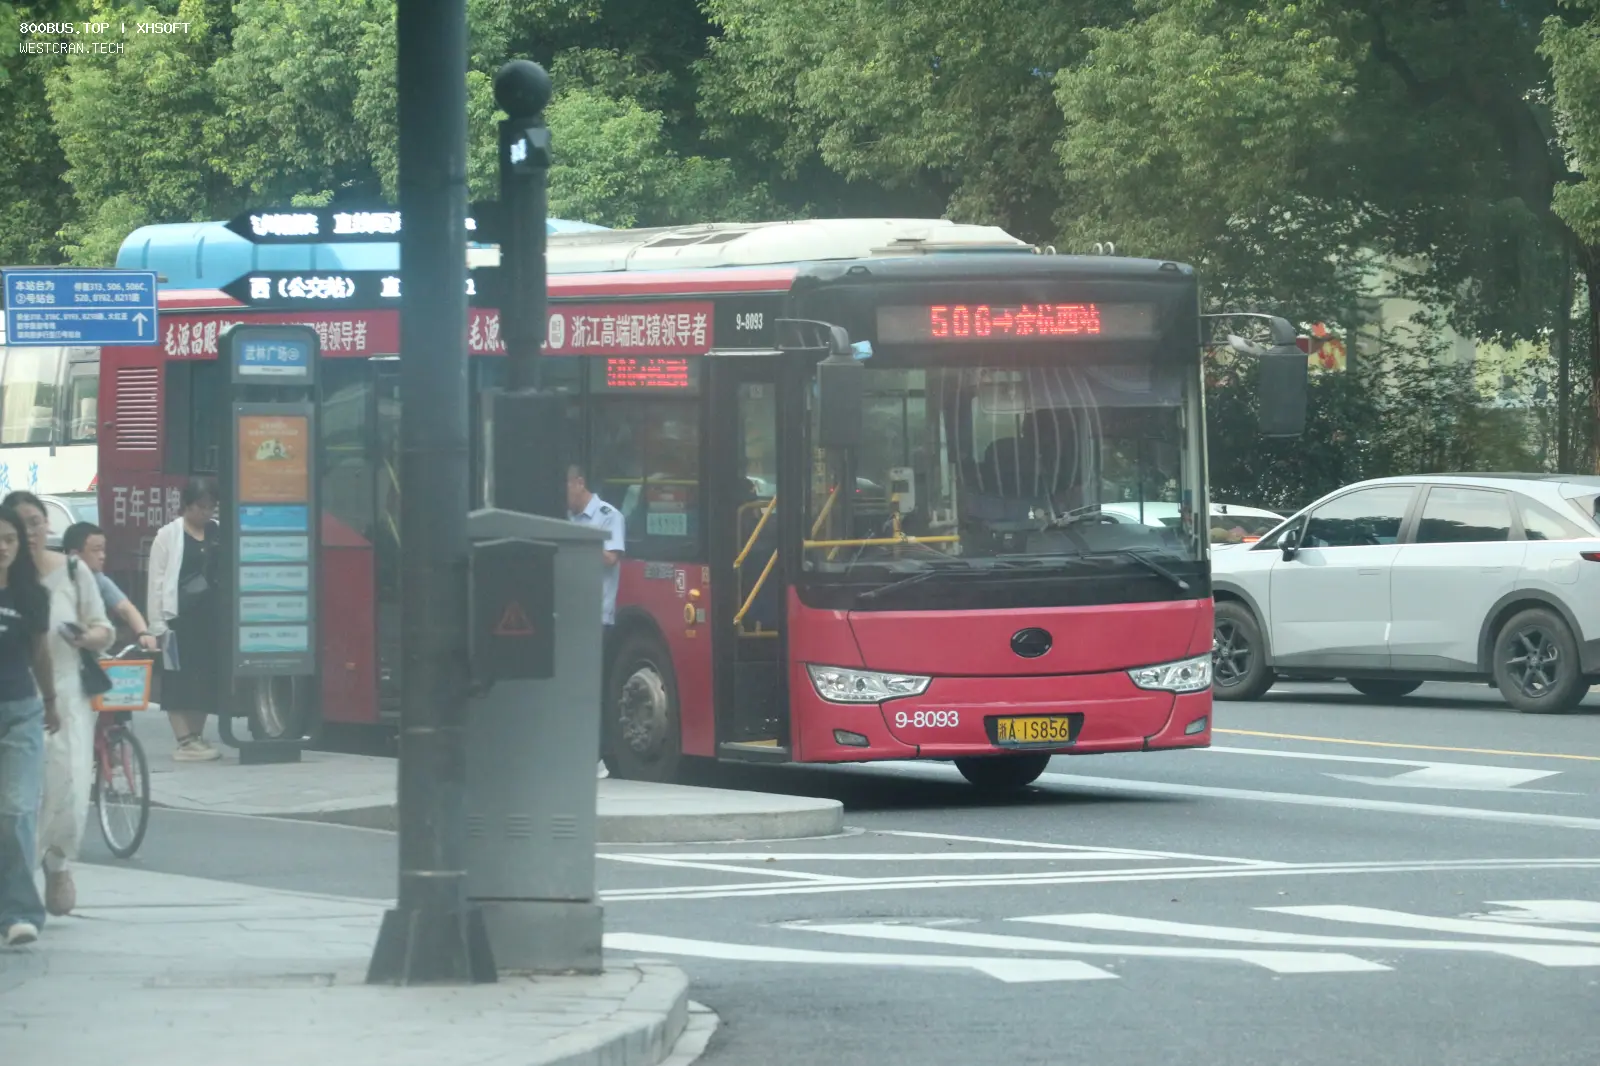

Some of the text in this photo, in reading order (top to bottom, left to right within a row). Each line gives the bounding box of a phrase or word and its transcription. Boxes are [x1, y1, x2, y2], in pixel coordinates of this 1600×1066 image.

[15, 280, 55, 291] 本站台为
[736, 313, 763, 331] 9-8093
[468, 314, 507, 352] 毛源
[571, 313, 707, 348] 浙江高端配镜领导者
[112, 485, 181, 527] 百年品牌
[895, 710, 960, 729] 9-8093
